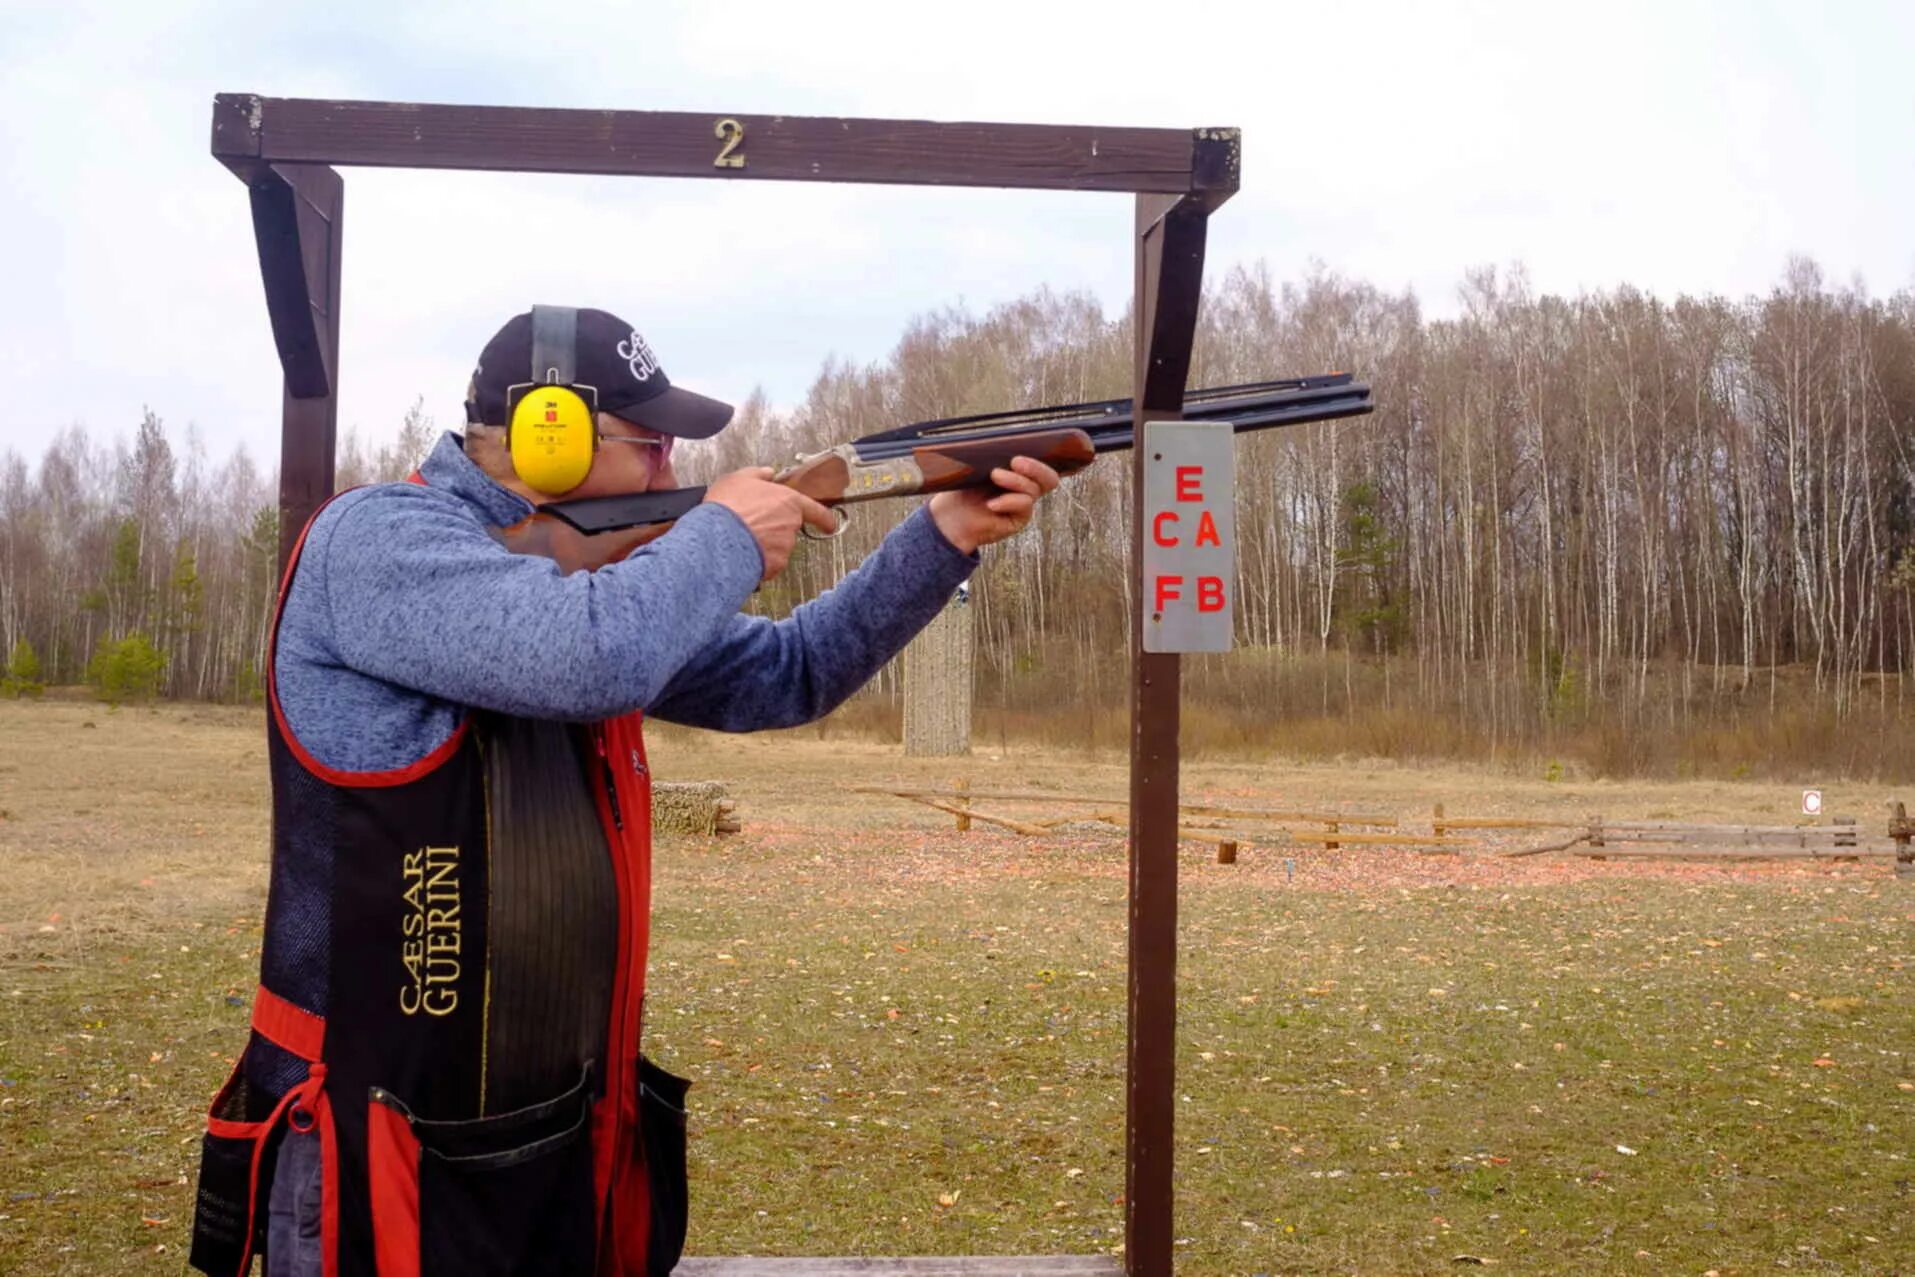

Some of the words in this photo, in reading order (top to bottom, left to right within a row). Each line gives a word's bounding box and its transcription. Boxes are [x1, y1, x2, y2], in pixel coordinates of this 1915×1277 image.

[714, 118, 745, 168] 2
[1175, 465, 1204, 503] E
[1153, 511, 1180, 548] C
[1194, 511, 1221, 547] A
[1155, 575, 1184, 613] F
[1197, 575, 1226, 613] B
[1804, 792, 1820, 812] C
[422, 845, 461, 1017] GUERINI
